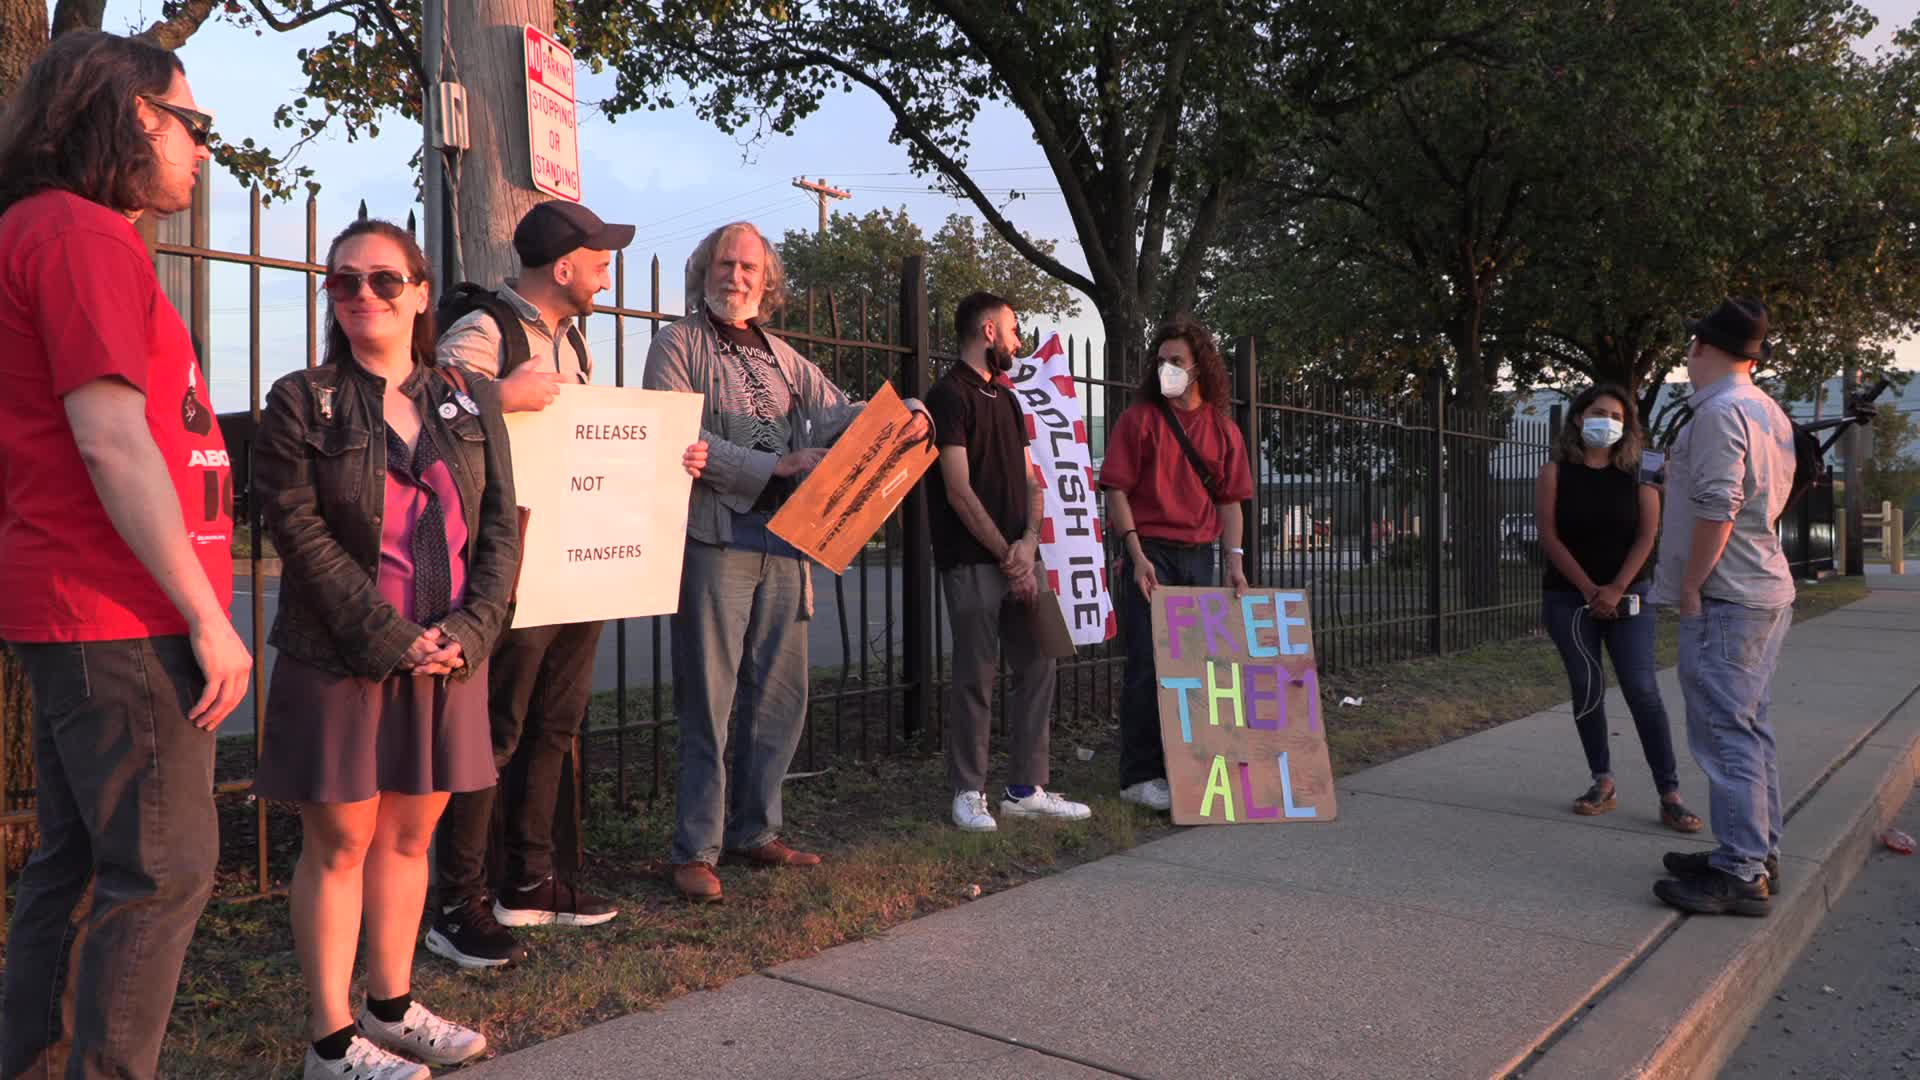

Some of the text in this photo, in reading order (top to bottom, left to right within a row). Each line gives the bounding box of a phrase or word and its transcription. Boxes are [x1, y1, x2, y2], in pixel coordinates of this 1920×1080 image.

[528, 38, 571, 86] NO PARKING
[532, 90, 574, 128] STOPPING
[549, 130, 560, 152] OR
[536, 155, 577, 190] STANDING
[575, 424, 647, 440] RELEASES
[570, 476, 604, 492] NOT
[567, 544, 642, 563] TRANSFERS
[1068, 556, 1101, 629] ICE
[1164, 592, 1309, 659] FREE
[1160, 660, 1318, 743] THEM
[1200, 751, 1316, 822] ALL
